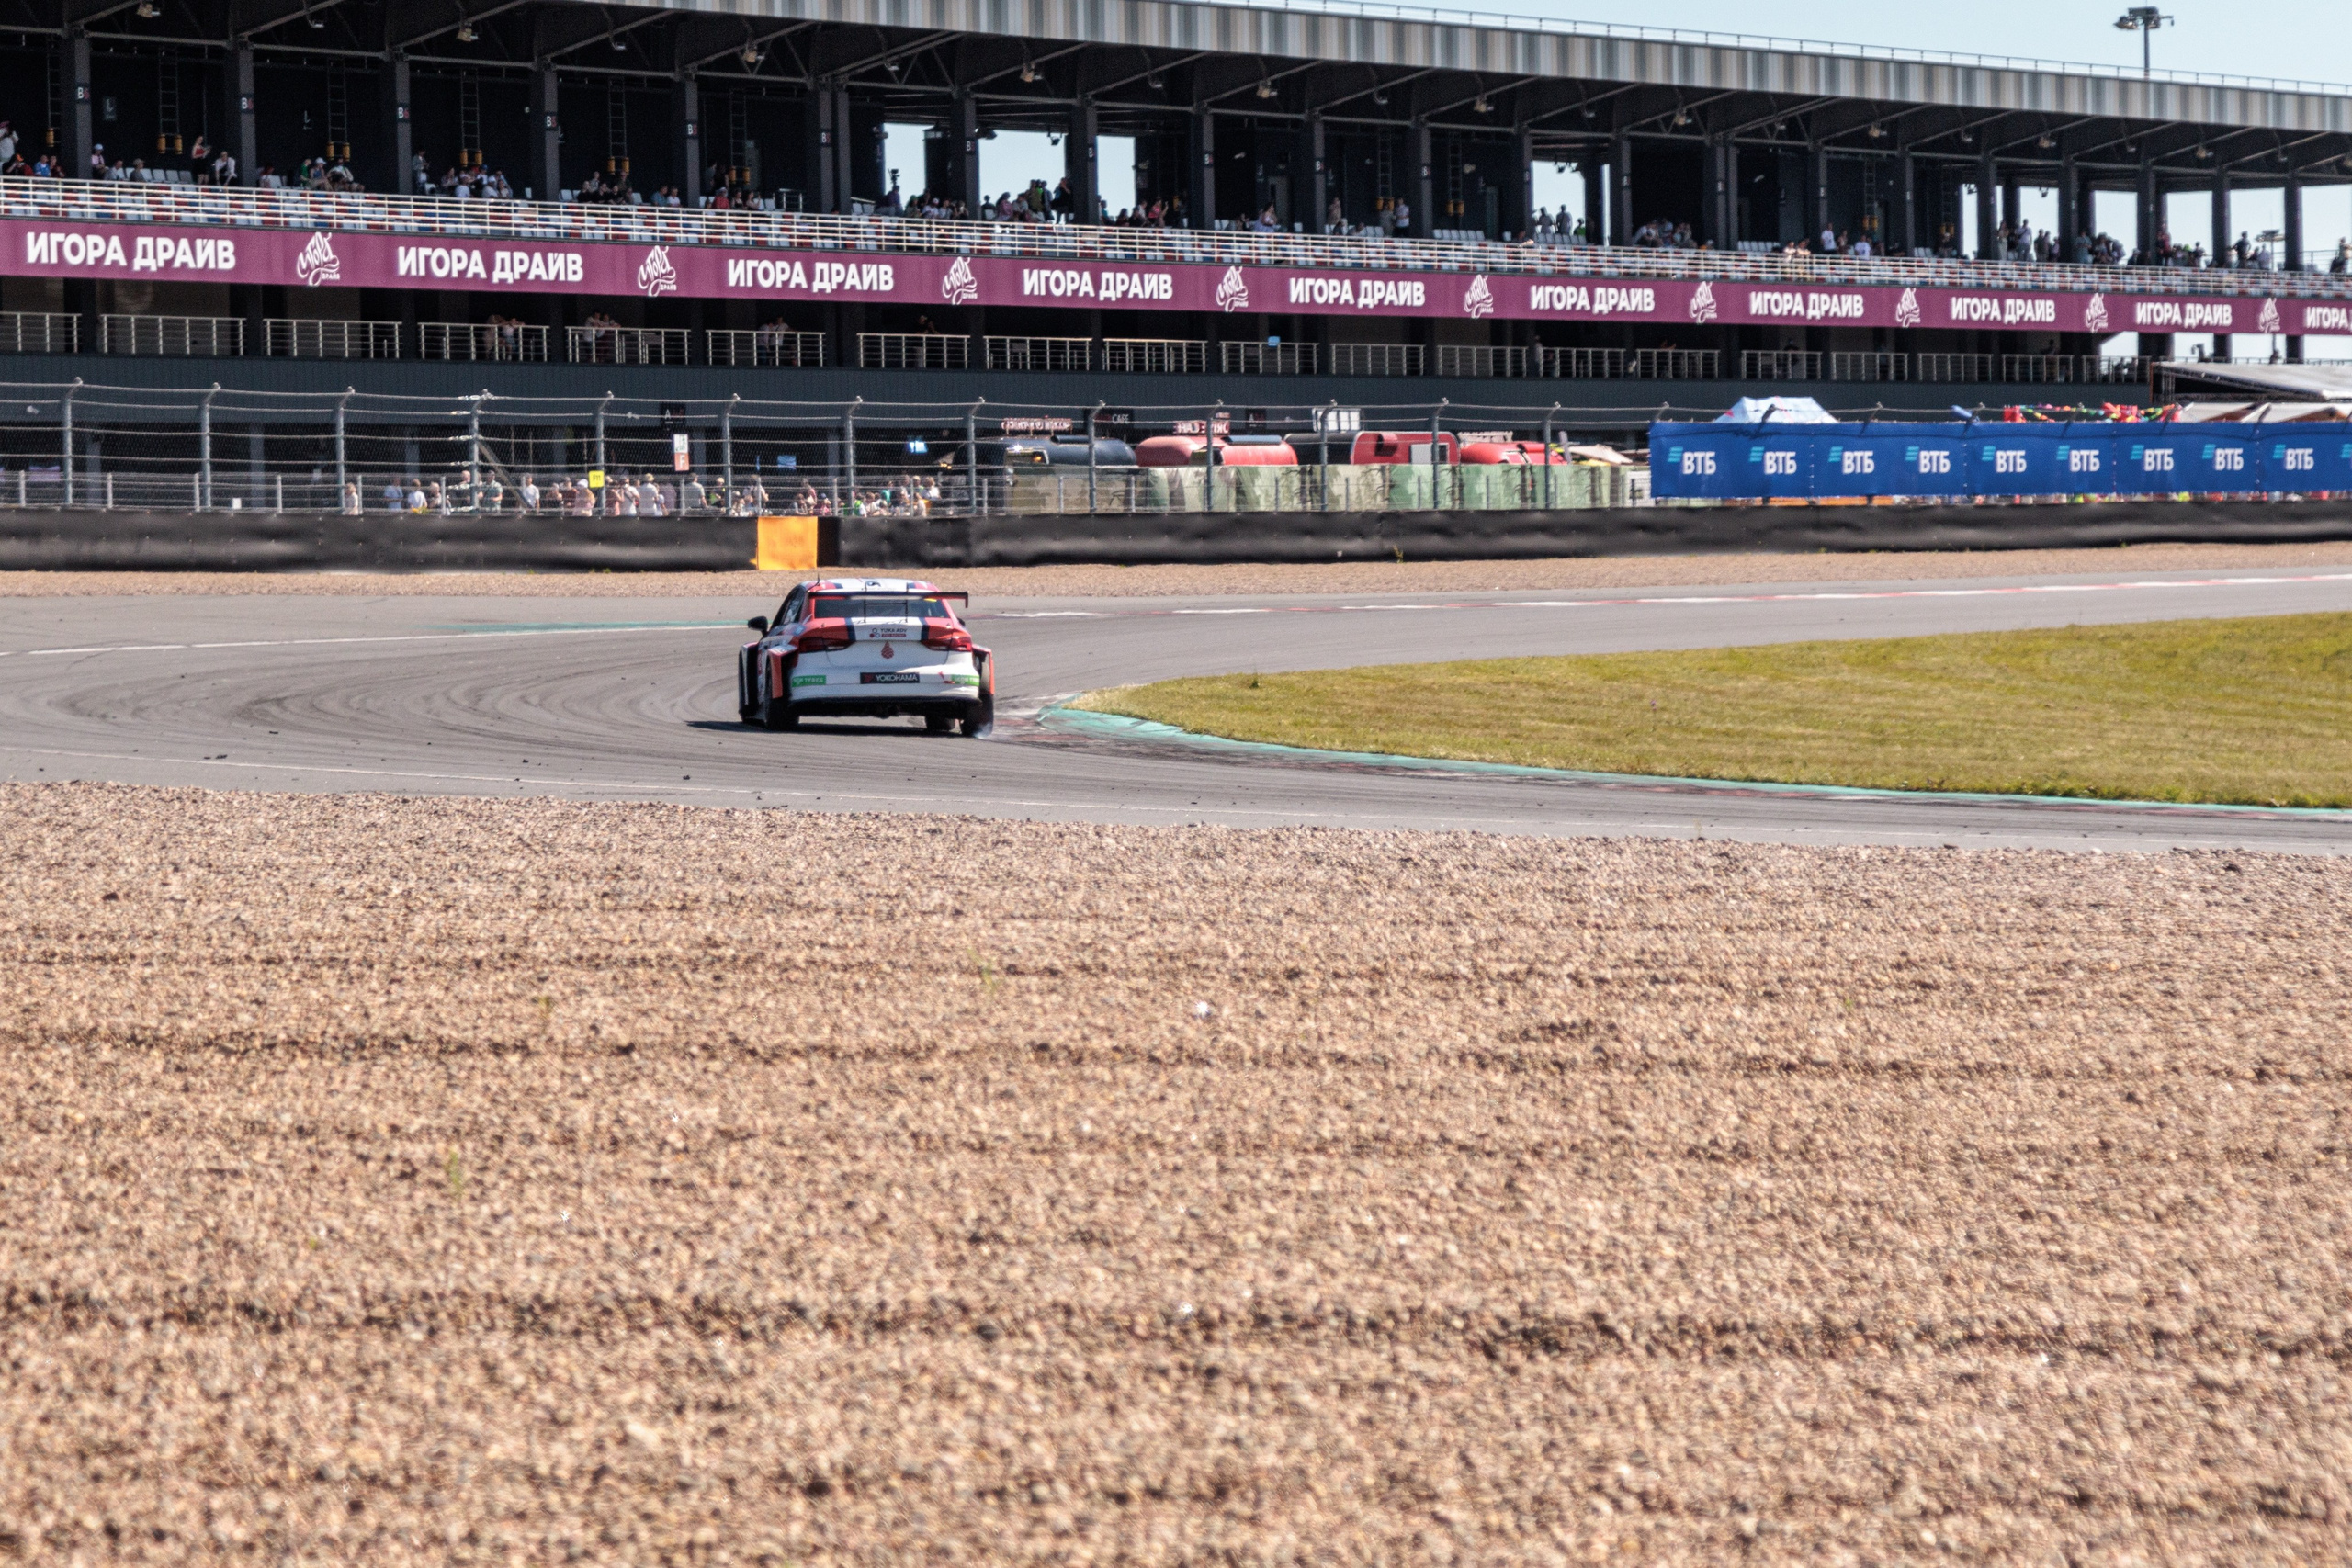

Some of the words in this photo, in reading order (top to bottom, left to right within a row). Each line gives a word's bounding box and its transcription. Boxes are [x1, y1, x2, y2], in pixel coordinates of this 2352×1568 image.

[26, 231, 128, 265] ИГОРА
[132, 236, 236, 272] ДРАЙВ
[397, 245, 487, 279] ИГОРА
[492, 250, 584, 284] ДРАЙВ
[728, 258, 808, 289] ИГОРА
[812, 261, 894, 294] ДРАЙВ
[1023, 268, 1096, 298] ИГОРА
[1099, 271, 1173, 301] ДРАЙВ
[1289, 277, 1355, 305] ИГОРА
[1357, 279, 1426, 309] ДРАЙВ
[1530, 285, 1591, 310] ИГОРА
[1749, 291, 1805, 316] ИГОРА
[1951, 296, 2002, 321] ИГОРА
[2136, 302, 2182, 325] ИГОРА
[2305, 306, 2348, 329] ИГОРА
[1682, 451, 1717, 475] ВТБ
[1764, 451, 1797, 475] ВТБ
[1842, 450, 1875, 474] ВТБ
[1918, 450, 1951, 474] ВТБ
[1996, 450, 2027, 473] ВТБ
[2069, 449, 2100, 472] ВТБ
[2143, 448, 2175, 472] ВТБ
[2214, 448, 2244, 471] ВТБ
[2285, 447, 2314, 470] ВТБ
[875, 674, 918, 682] YOKOHAMA
